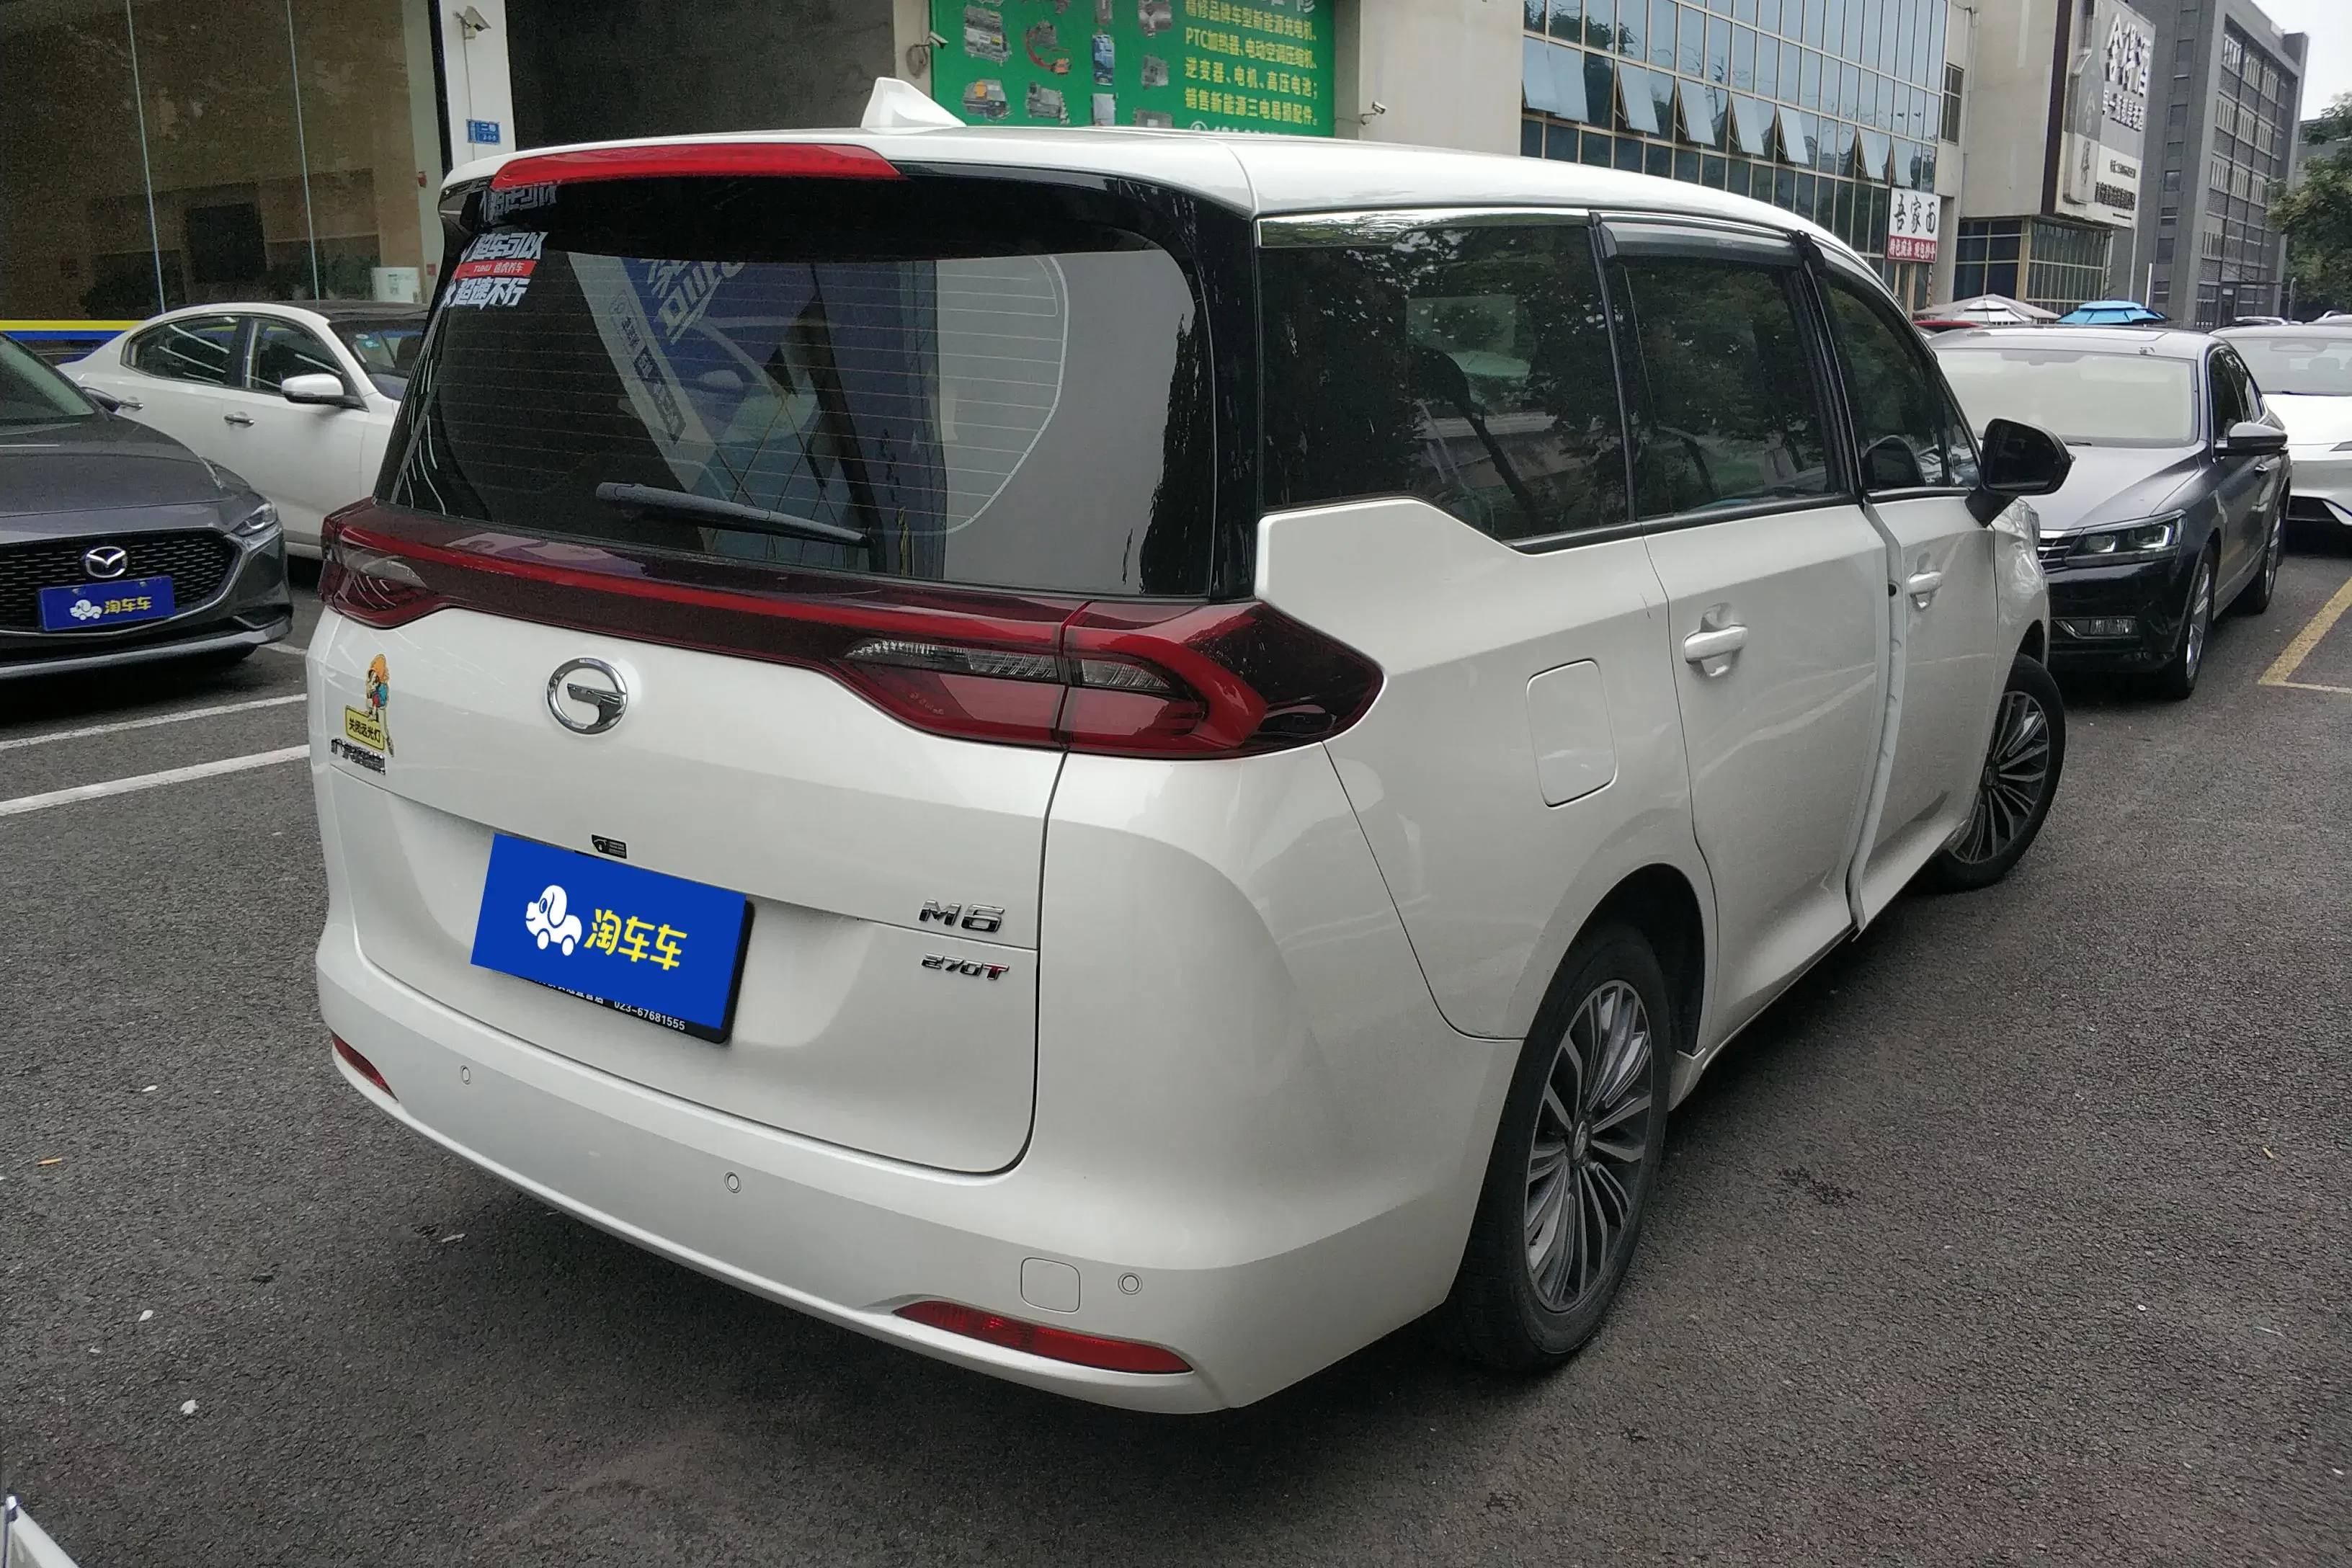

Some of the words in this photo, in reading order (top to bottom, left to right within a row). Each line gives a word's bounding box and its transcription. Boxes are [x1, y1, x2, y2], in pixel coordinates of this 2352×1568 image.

[467, 232, 548, 262] 超车可以
[449, 277, 530, 310] 超速不行
[349, 717, 380, 743] 关闭远光灯
[918, 899, 1006, 933] M6
[921, 953, 1010, 981] 270T
[614, 1001, 685, 1031] 023-67681555
